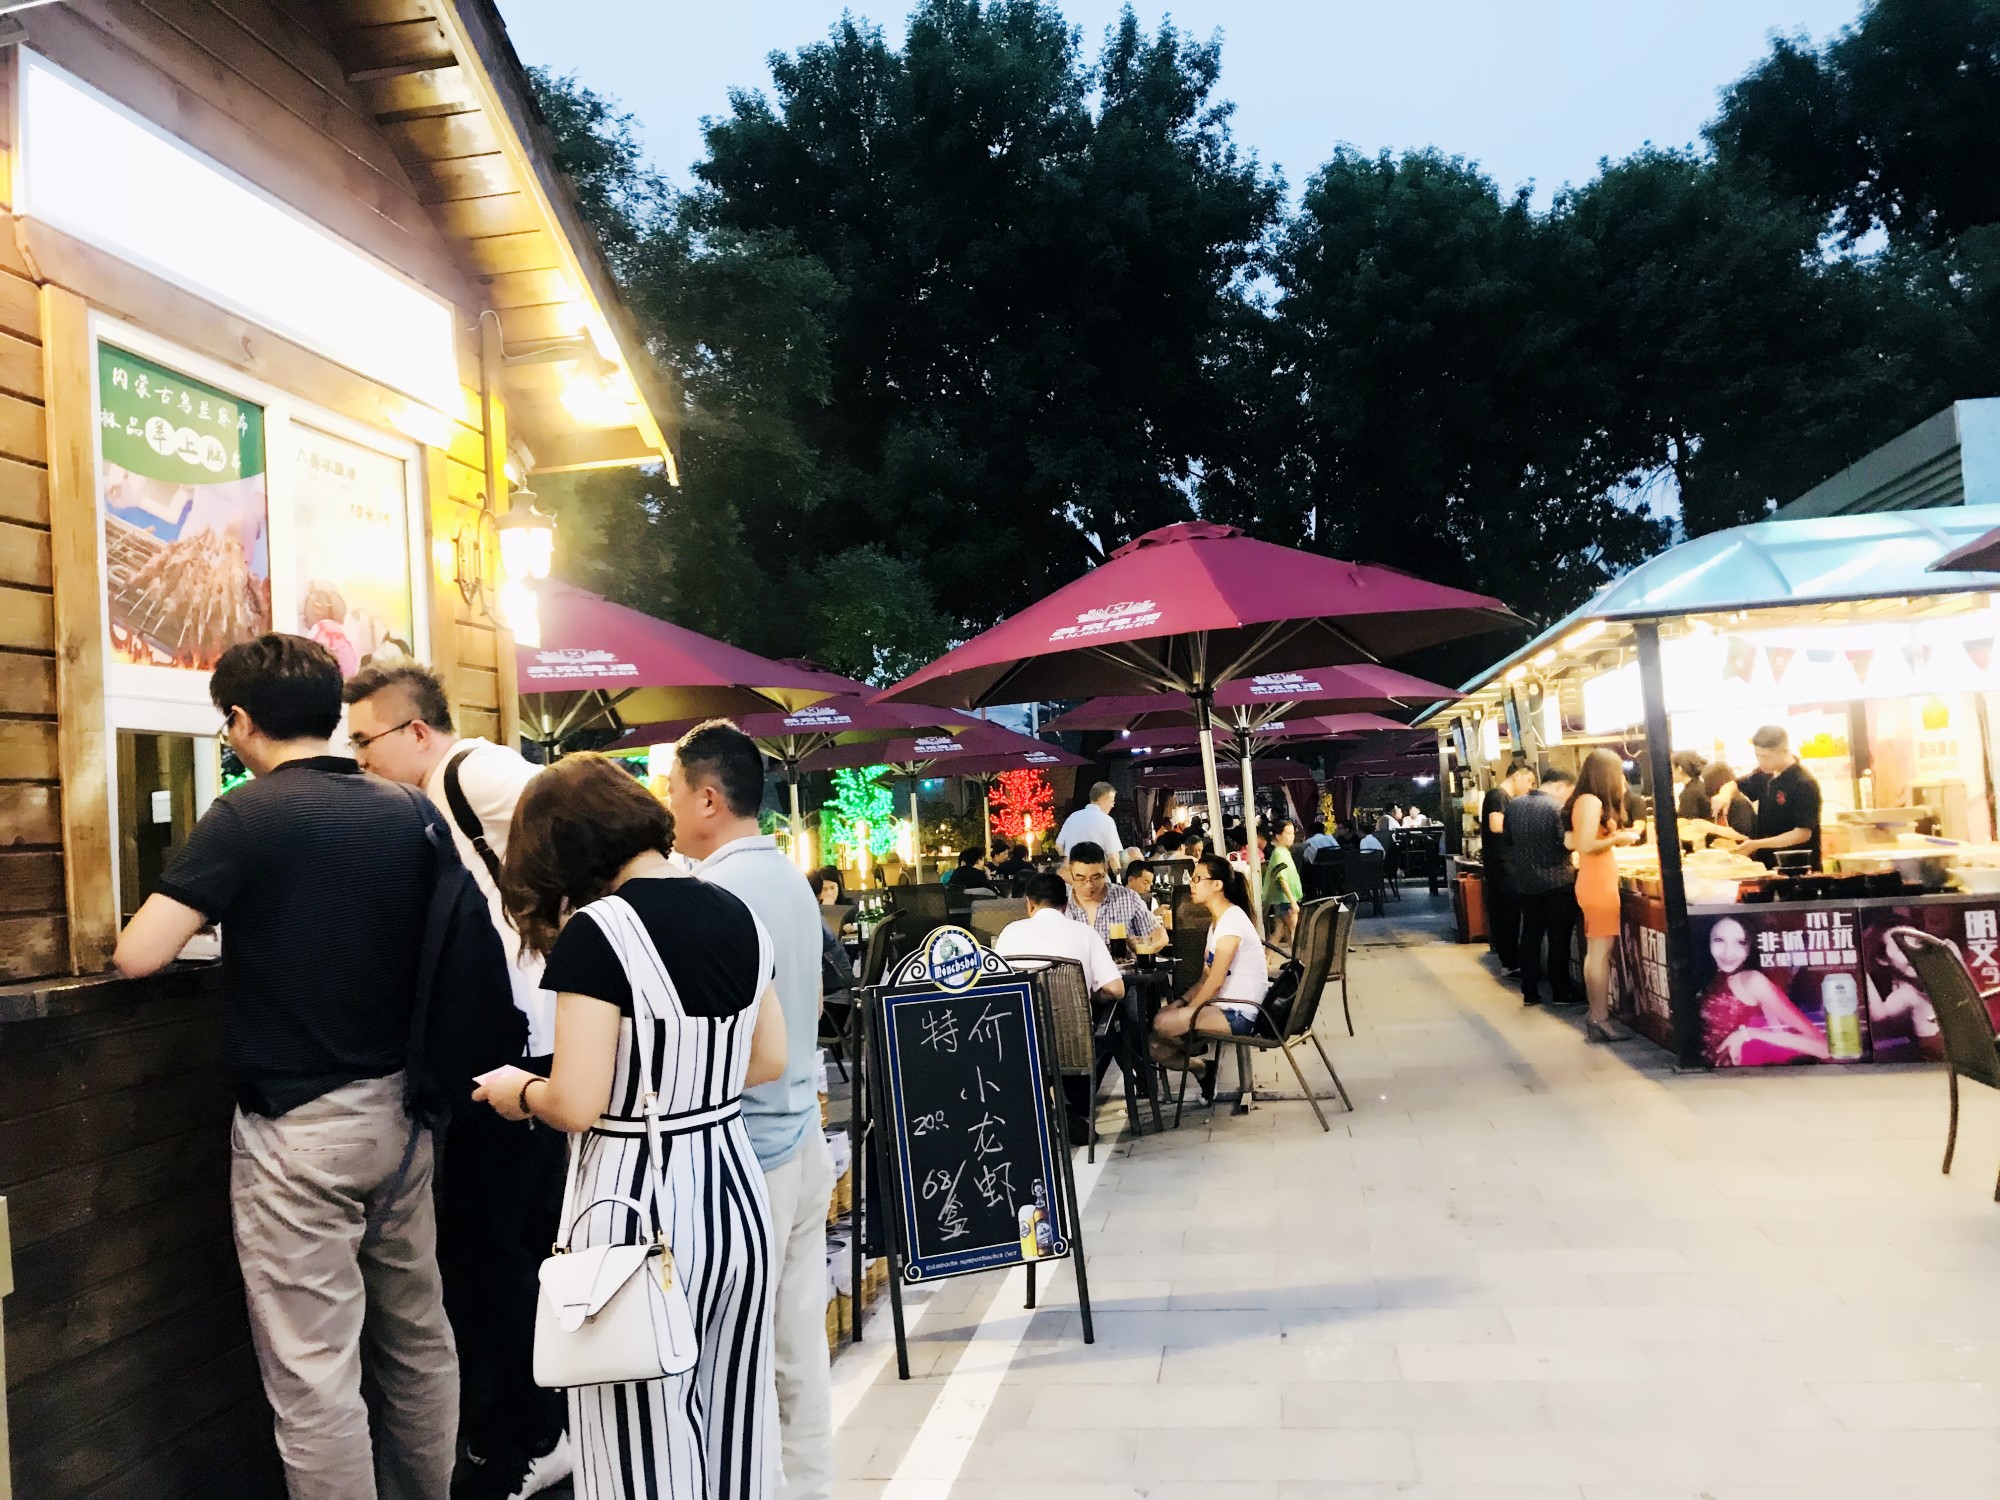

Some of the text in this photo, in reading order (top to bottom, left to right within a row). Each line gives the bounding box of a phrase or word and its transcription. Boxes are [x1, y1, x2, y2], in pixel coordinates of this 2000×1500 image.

[920, 1002, 1012, 1063] 特价
[960, 1065, 1017, 1218] 小龙虾
